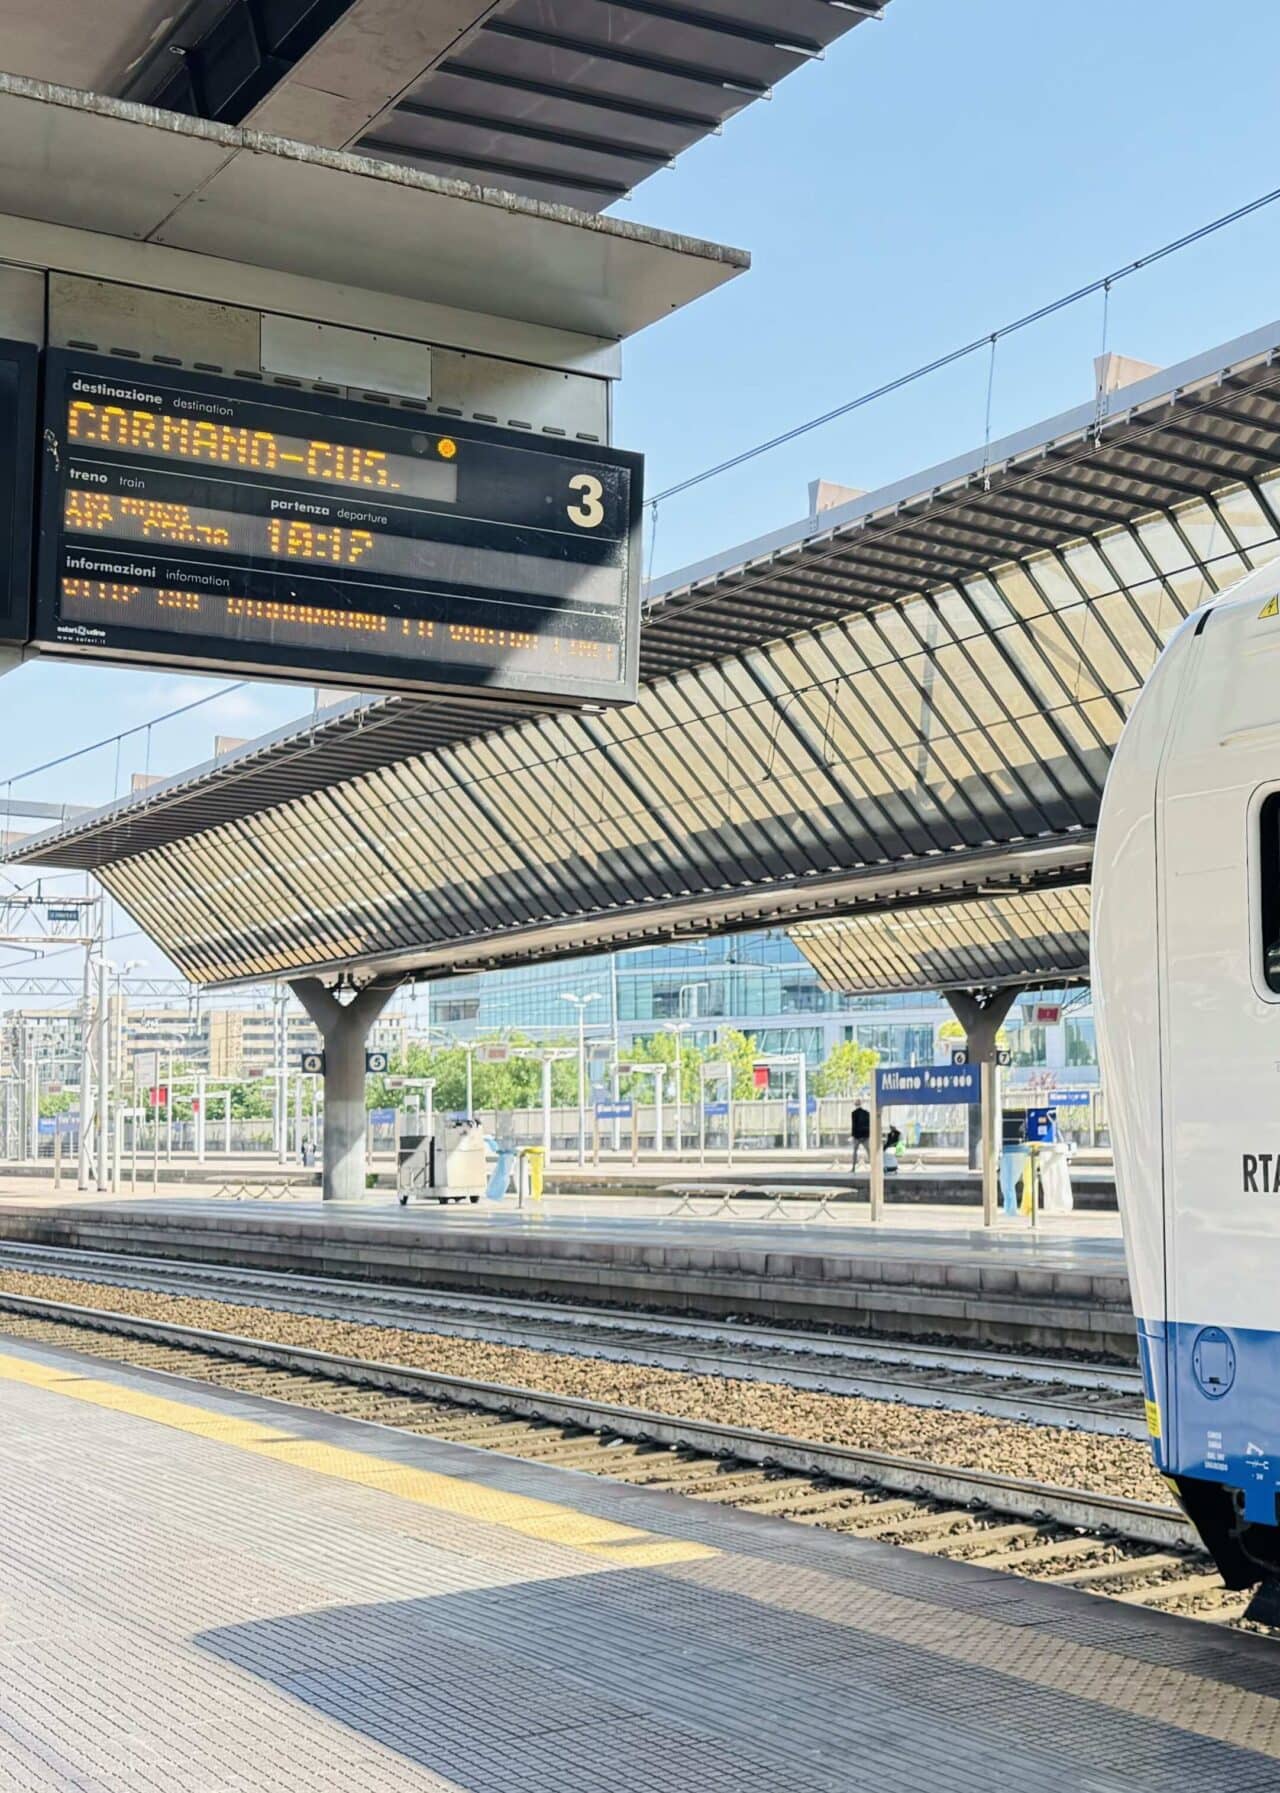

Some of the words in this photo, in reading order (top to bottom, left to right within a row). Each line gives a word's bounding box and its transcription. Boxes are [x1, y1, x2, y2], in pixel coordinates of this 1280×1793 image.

[71, 379, 163, 405] destinazione
[172, 396, 234, 417] destination
[69, 468, 108, 484] treno
[119, 476, 145, 489] train
[270, 499, 330, 516] partenza
[336, 508, 388, 525] departure
[566, 473, 605, 528] 3
[65, 556, 157, 579] informazioni
[165, 569, 230, 587] information
